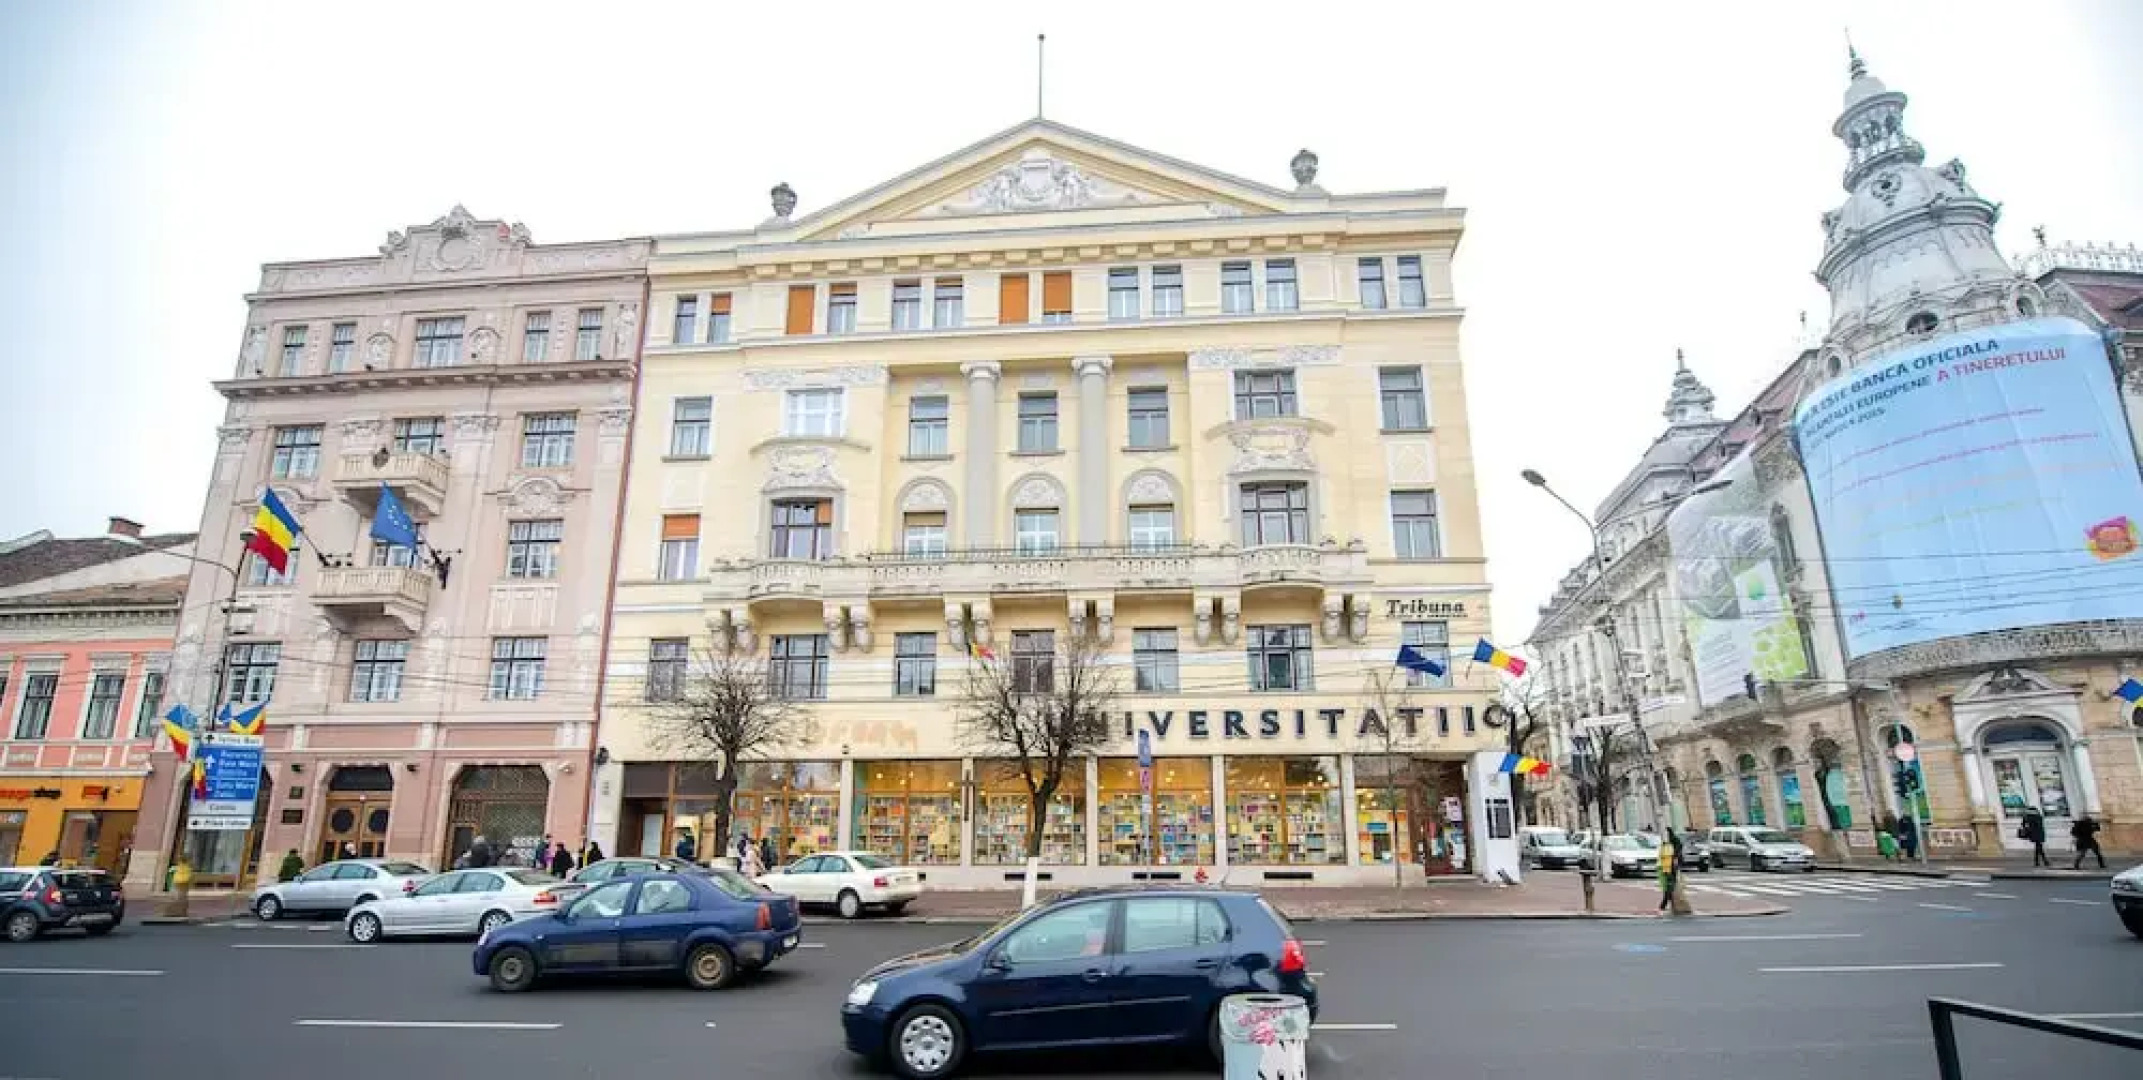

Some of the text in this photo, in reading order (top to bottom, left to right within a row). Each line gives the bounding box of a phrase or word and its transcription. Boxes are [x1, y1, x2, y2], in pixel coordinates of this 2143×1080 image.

[1851, 363, 1910, 393] BANCA
[1913, 338, 1999, 370] OFICIALA
[1857, 375, 1931, 409] EUROPENE
[1936, 369, 1950, 383] A
[1952, 347, 2067, 376] TINERETULUI
[1386, 598, 1465, 614] Tribuna
